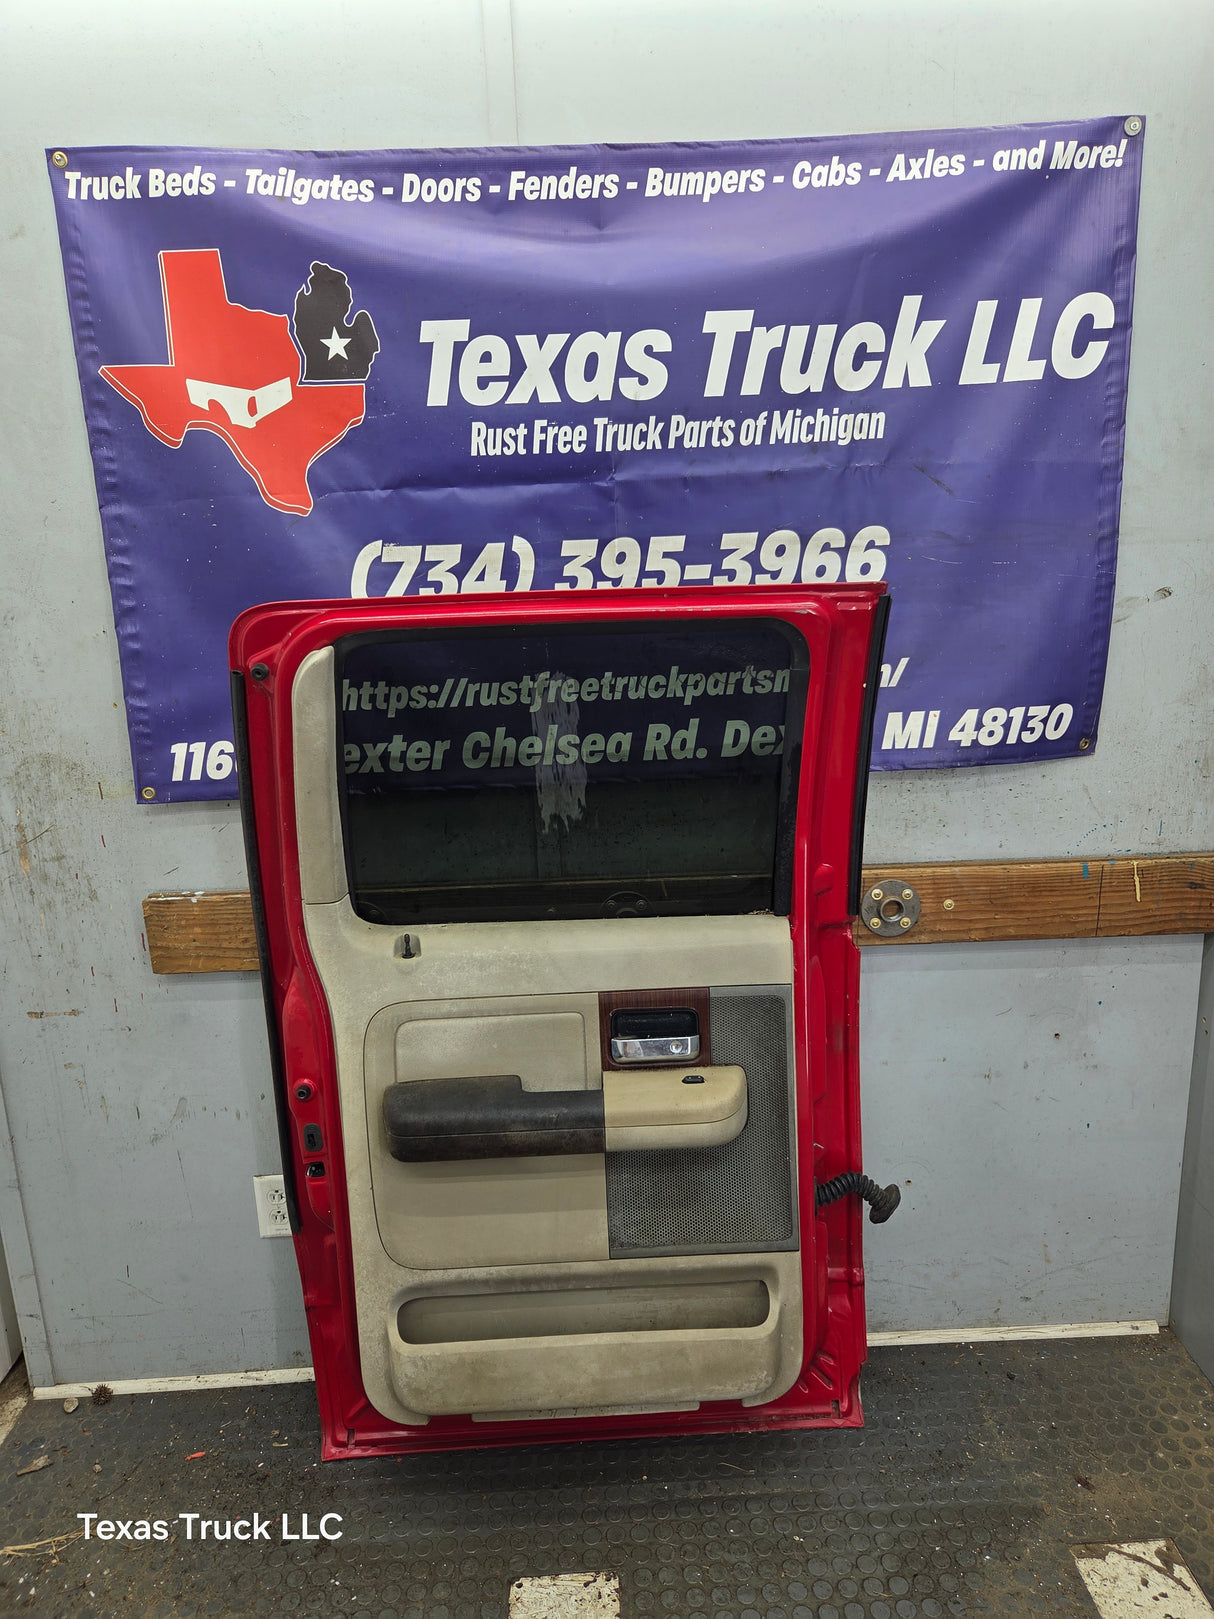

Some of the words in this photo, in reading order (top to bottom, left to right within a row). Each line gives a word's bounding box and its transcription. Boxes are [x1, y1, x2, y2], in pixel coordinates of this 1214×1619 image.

[64, 166, 142, 200] Truck
[148, 165, 217, 198] Beds
[245, 167, 375, 206] Tailgates
[401, 173, 482, 203] Doors
[508, 166, 620, 201] Fenders
[644, 167, 767, 203] Bumpers
[791, 155, 863, 190] Cabs
[886, 148, 967, 182] Axles
[992, 139, 1047, 172] and
[1049, 138, 1129, 170] More!
[419, 319, 673, 407] Texas
[701, 295, 947, 398] Truck
[958, 291, 1115, 386] LLC
[470, 421, 528, 457] Rust
[532, 419, 588, 455] Free
[593, 416, 664, 453] Truck
[668, 414, 736, 449] Parts
[740, 411, 768, 447] of
[769, 407, 887, 446] Michigan
[350, 535, 535, 599] (734)
[554, 525, 891, 591] 395-3966
[170, 740, 238, 782] 116
[462, 724, 633, 769] Chelsea
[642, 718, 708, 761] Rd.
[881, 710, 941, 750] MI
[948, 703, 1074, 747] 48130
